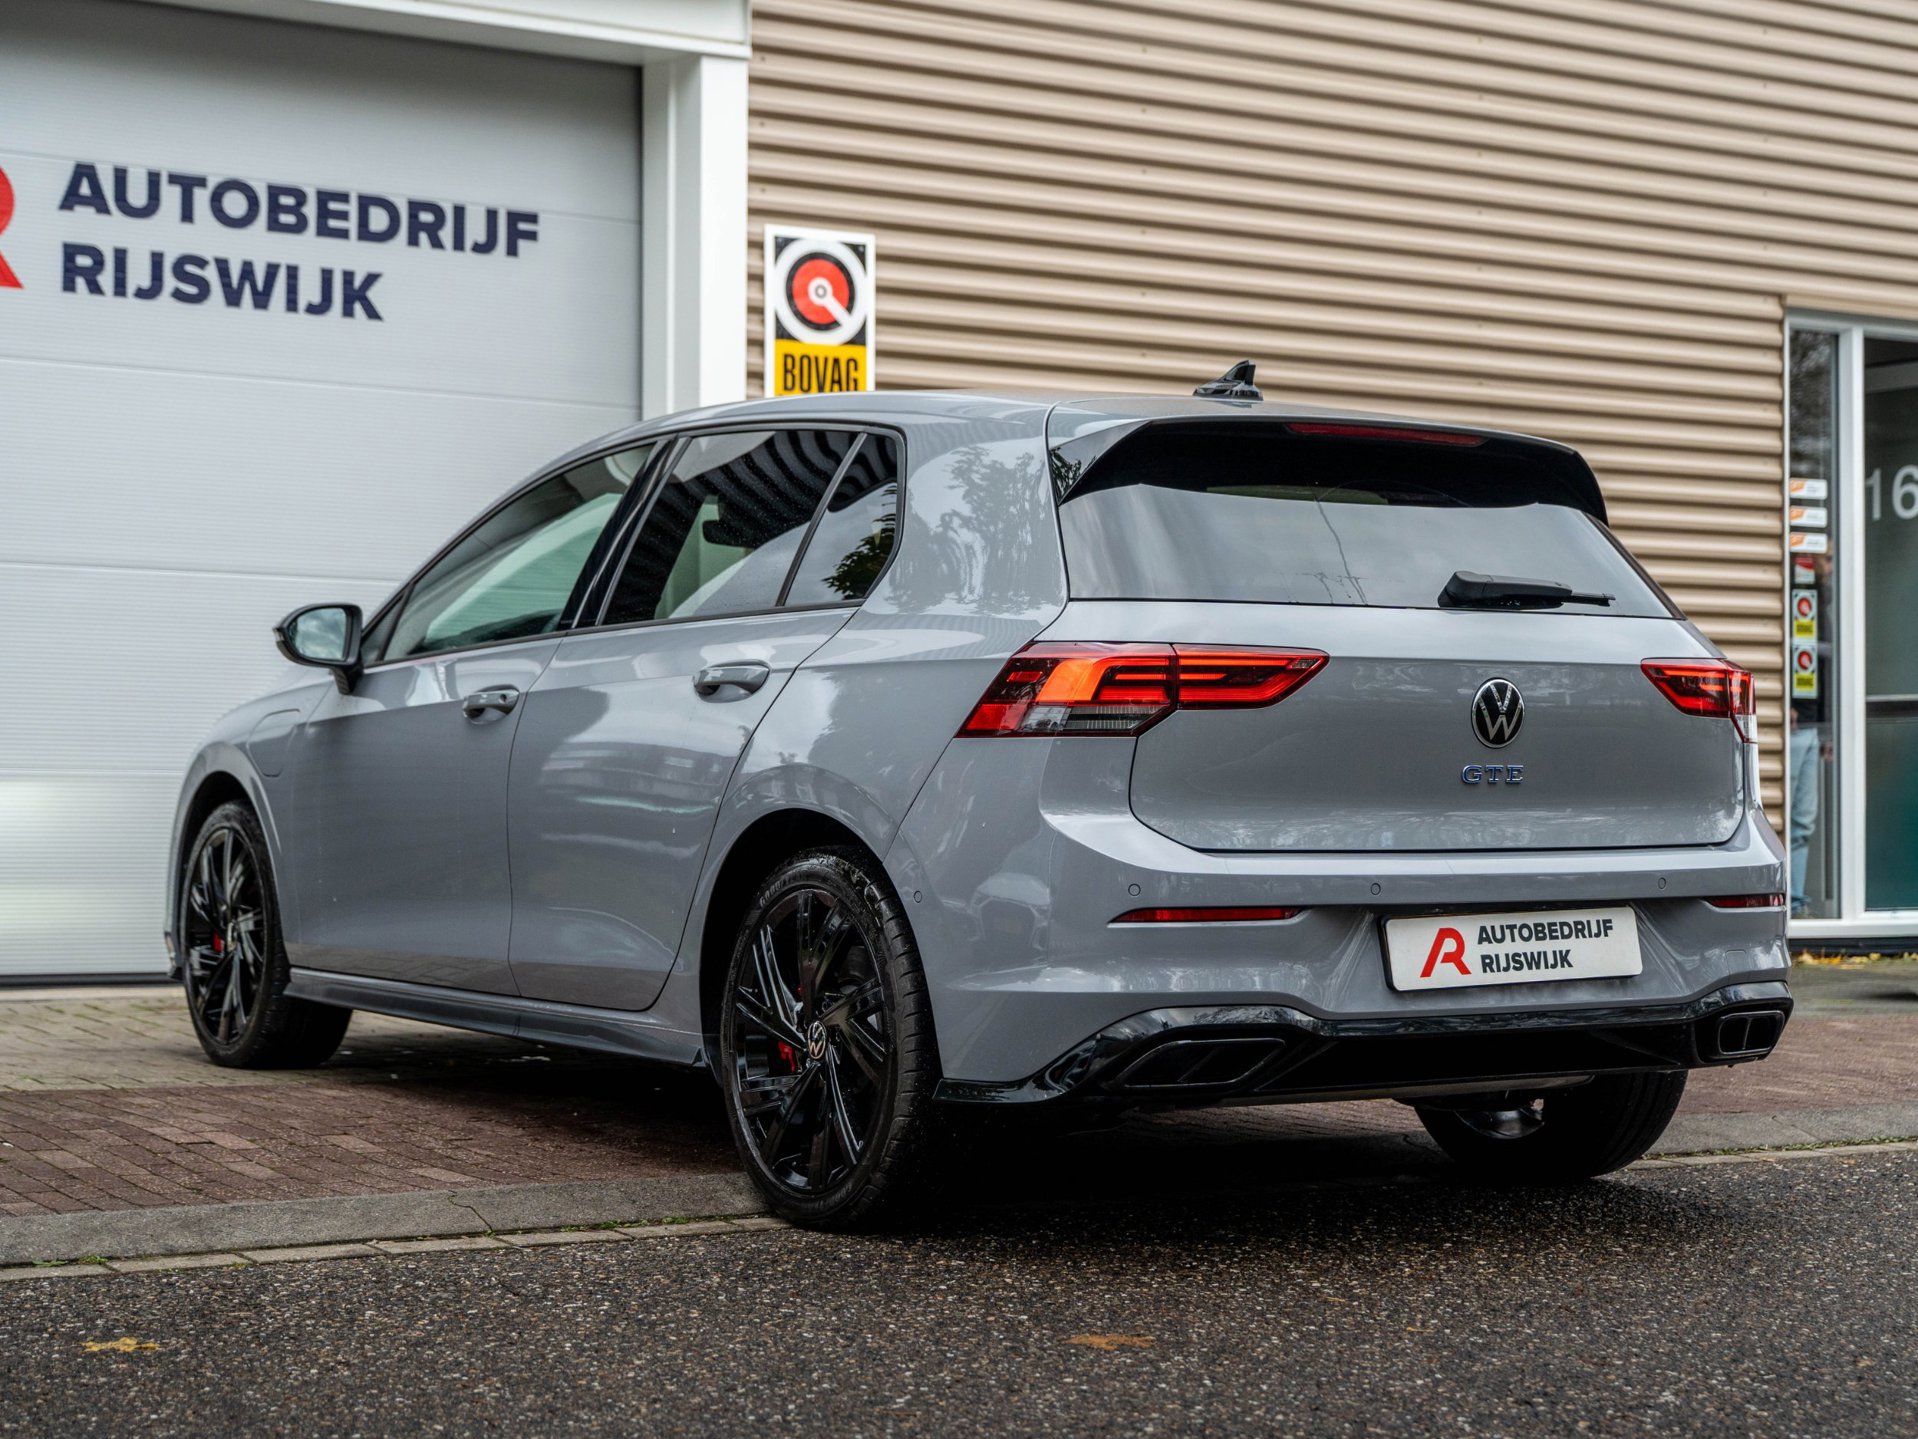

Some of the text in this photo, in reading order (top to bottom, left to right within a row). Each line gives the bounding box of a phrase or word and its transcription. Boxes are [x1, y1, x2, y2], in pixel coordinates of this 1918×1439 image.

[59, 162, 539, 257] AUTOBEDRIJF
[62, 242, 384, 321] RIJSWIJK
[783, 353, 858, 392] BOVAG
[1865, 465, 1918, 519] 16
[1462, 764, 1524, 784] GTE
[1477, 919, 1613, 945] AUTOBEDRIJF
[1480, 949, 1573, 974] RIJSWIJK
